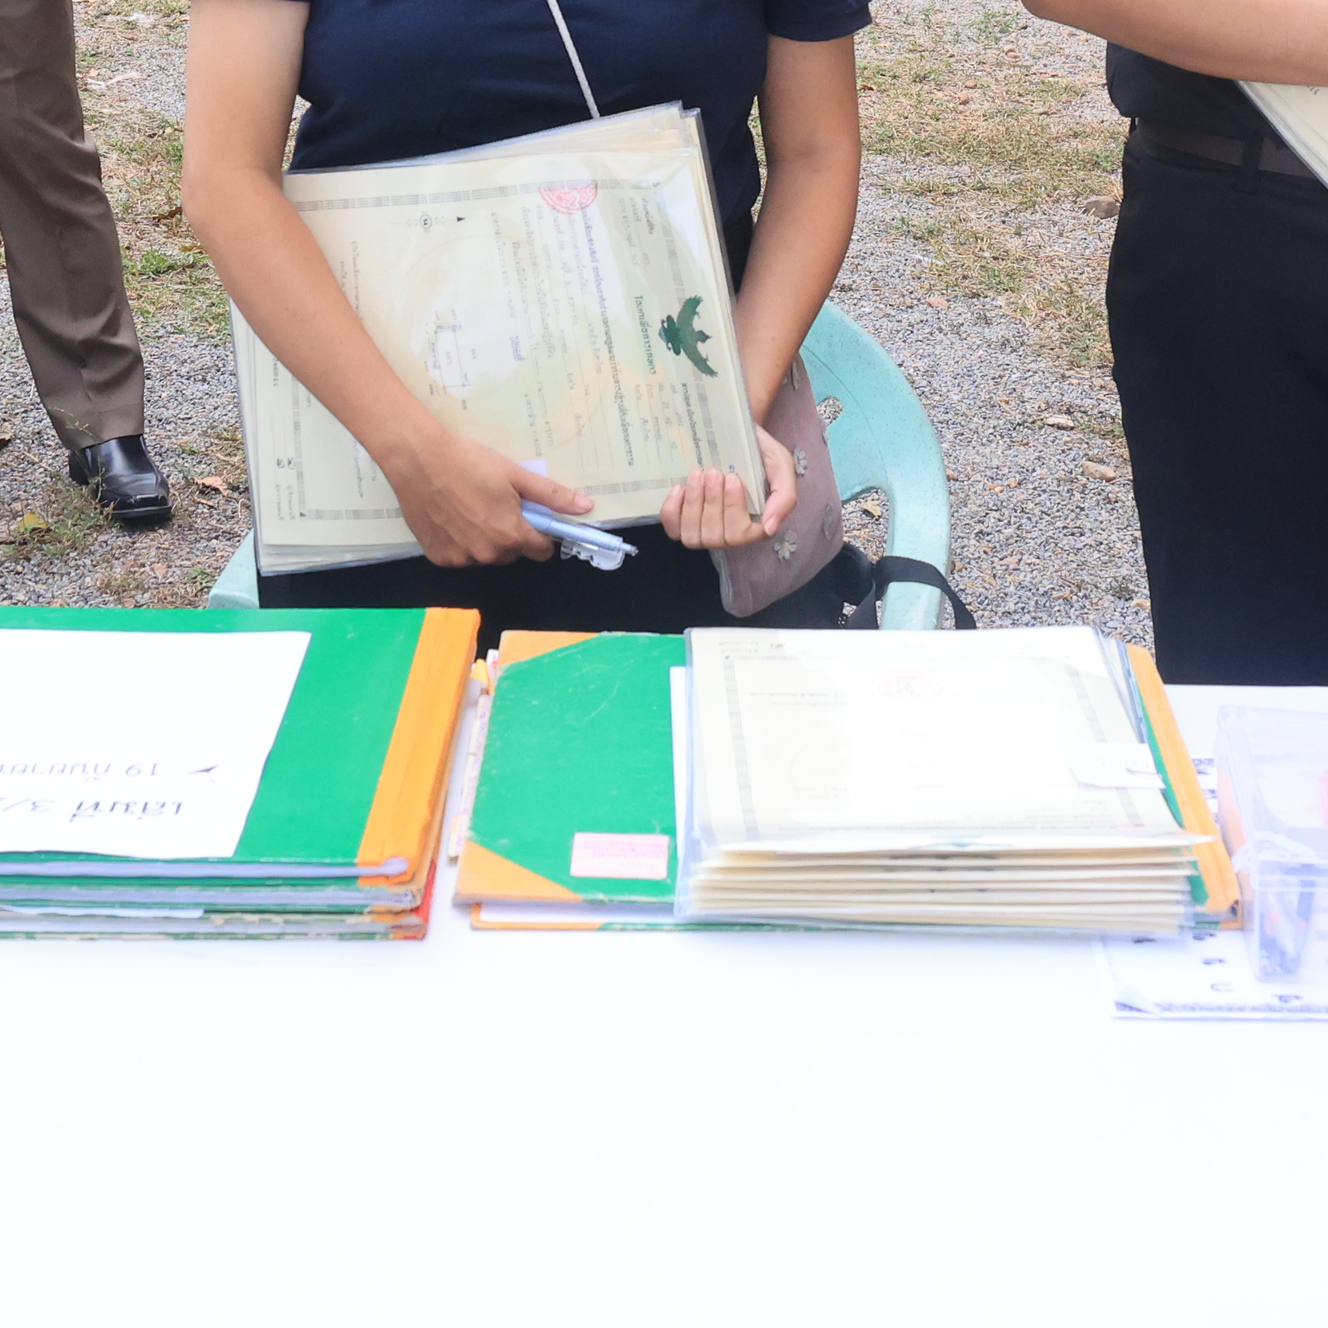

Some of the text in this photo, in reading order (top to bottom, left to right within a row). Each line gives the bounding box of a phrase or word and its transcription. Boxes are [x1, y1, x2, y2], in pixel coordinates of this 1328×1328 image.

[124, 762, 160, 777] 19
[69, 799, 183, 823] เล่มที่
